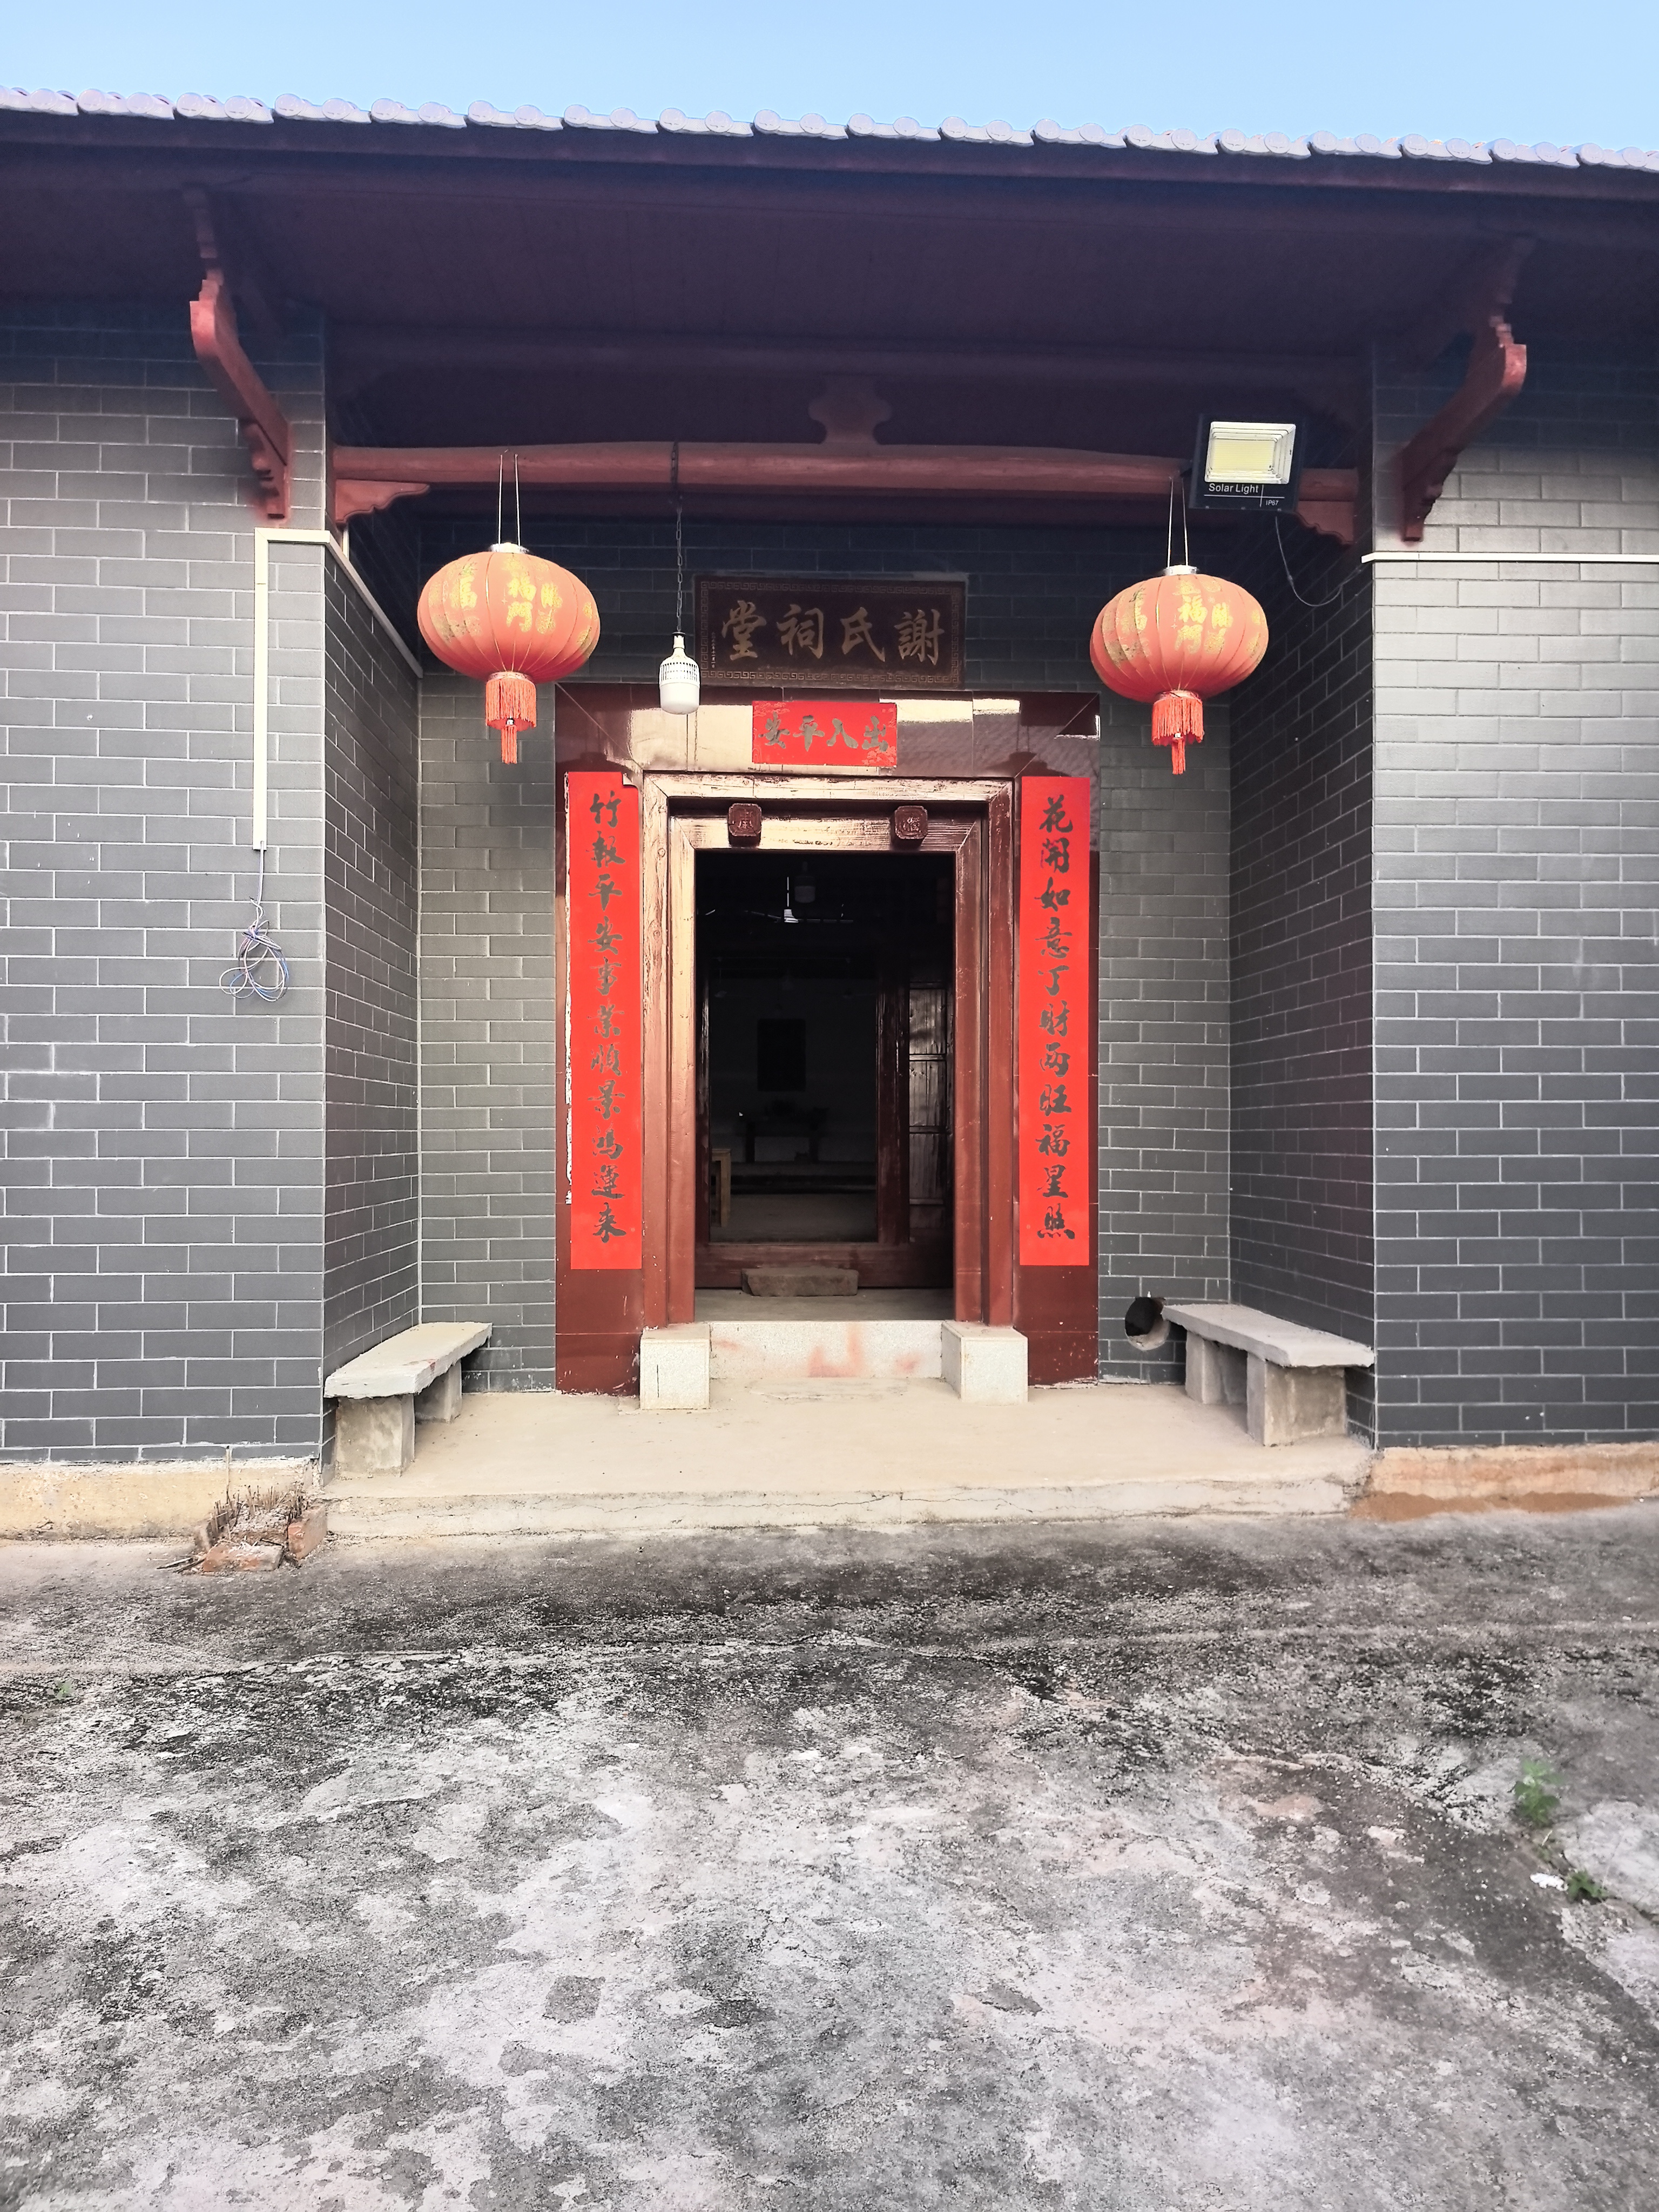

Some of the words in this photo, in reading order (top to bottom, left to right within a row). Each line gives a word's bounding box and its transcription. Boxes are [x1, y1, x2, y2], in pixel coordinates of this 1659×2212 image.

[1209, 483, 1233, 492] Solar
[1236, 484, 1259, 495] Light
[720, 600, 945, 665] 謝氏祠堂
[758, 711, 890, 753] 出入平安
